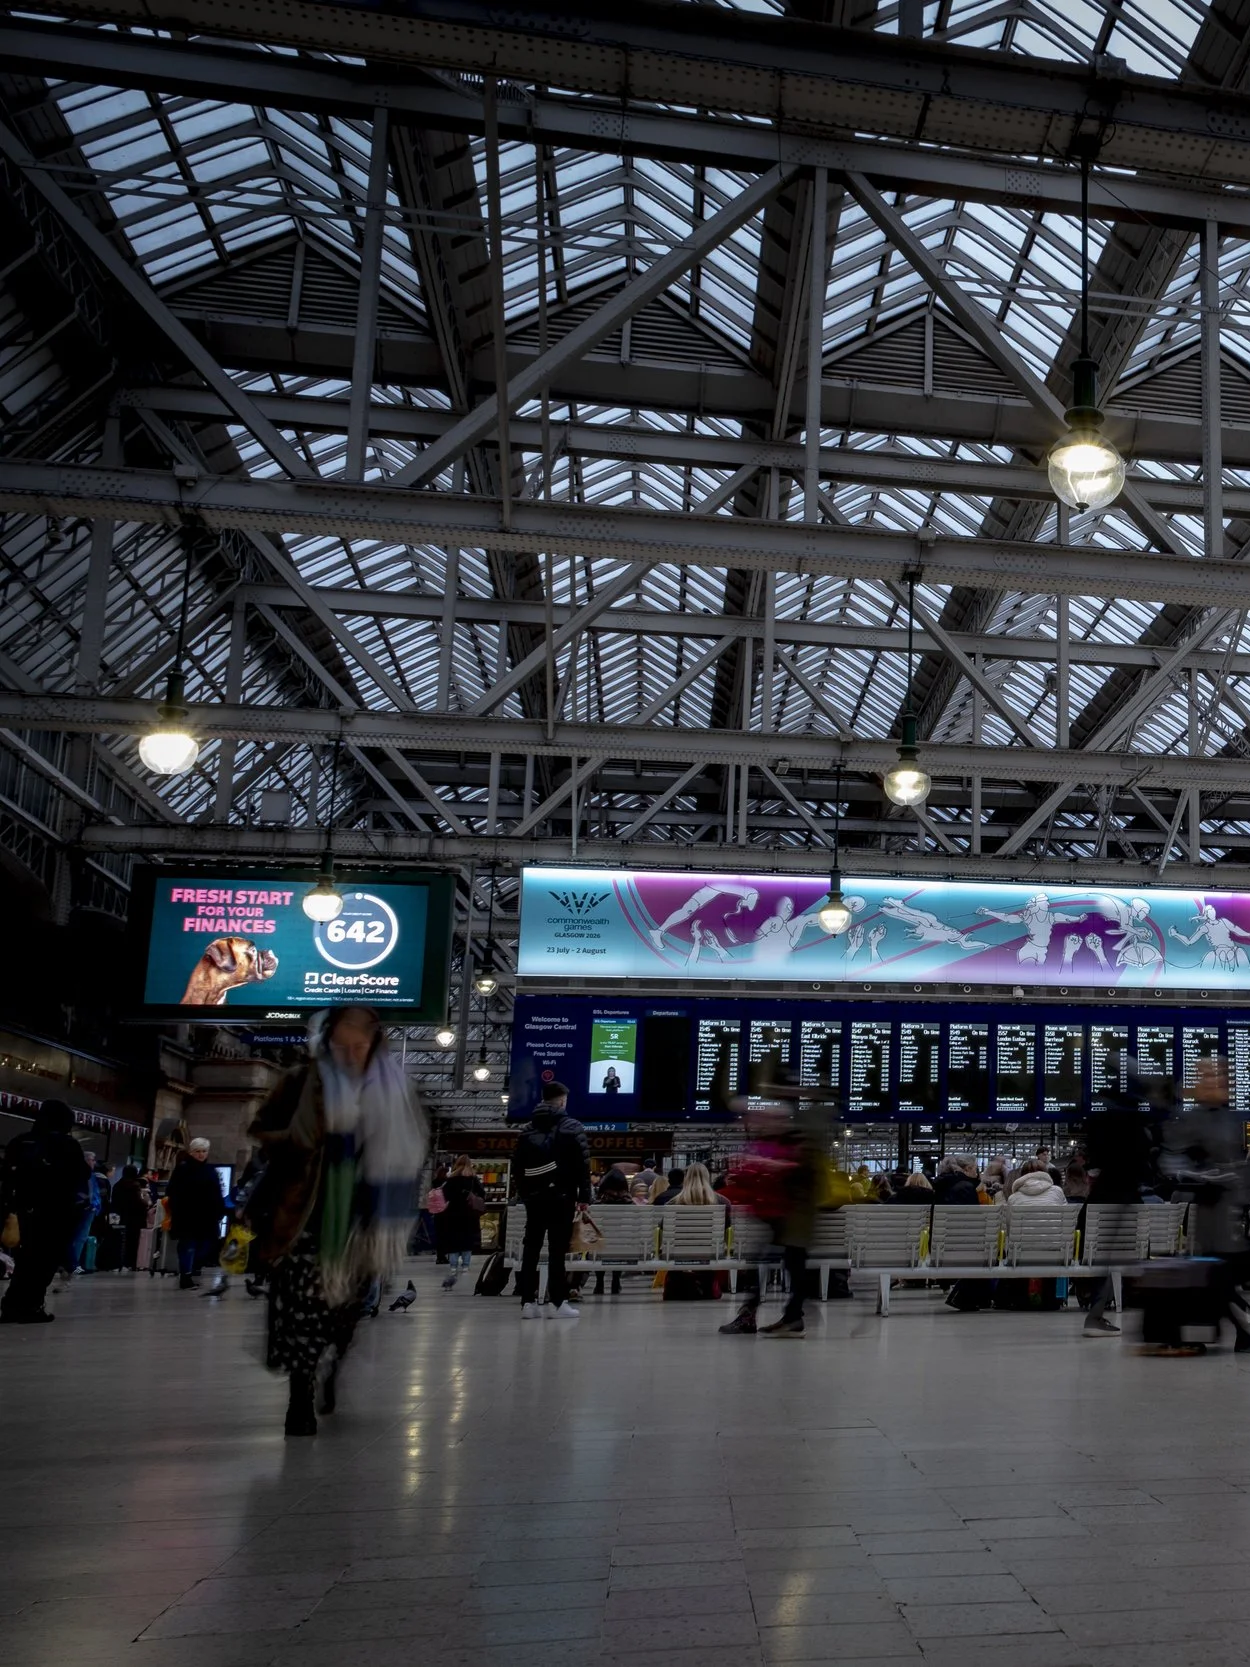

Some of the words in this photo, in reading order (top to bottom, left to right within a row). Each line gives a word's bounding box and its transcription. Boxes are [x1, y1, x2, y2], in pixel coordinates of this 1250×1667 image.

[171, 888, 233, 904] FRESH
[235, 890, 294, 905] START
[197, 906, 225, 916] FOR
[227, 906, 264, 917] YOUR
[183, 918, 276, 933] FINANCES
[547, 917, 610, 925] commonwealth
[327, 920, 385, 943] 642
[564, 924, 592, 932] games
[582, 947, 606, 955] August
[321, 973, 399, 986] ClearScore
[587, 1137, 645, 1149] COFFEE
